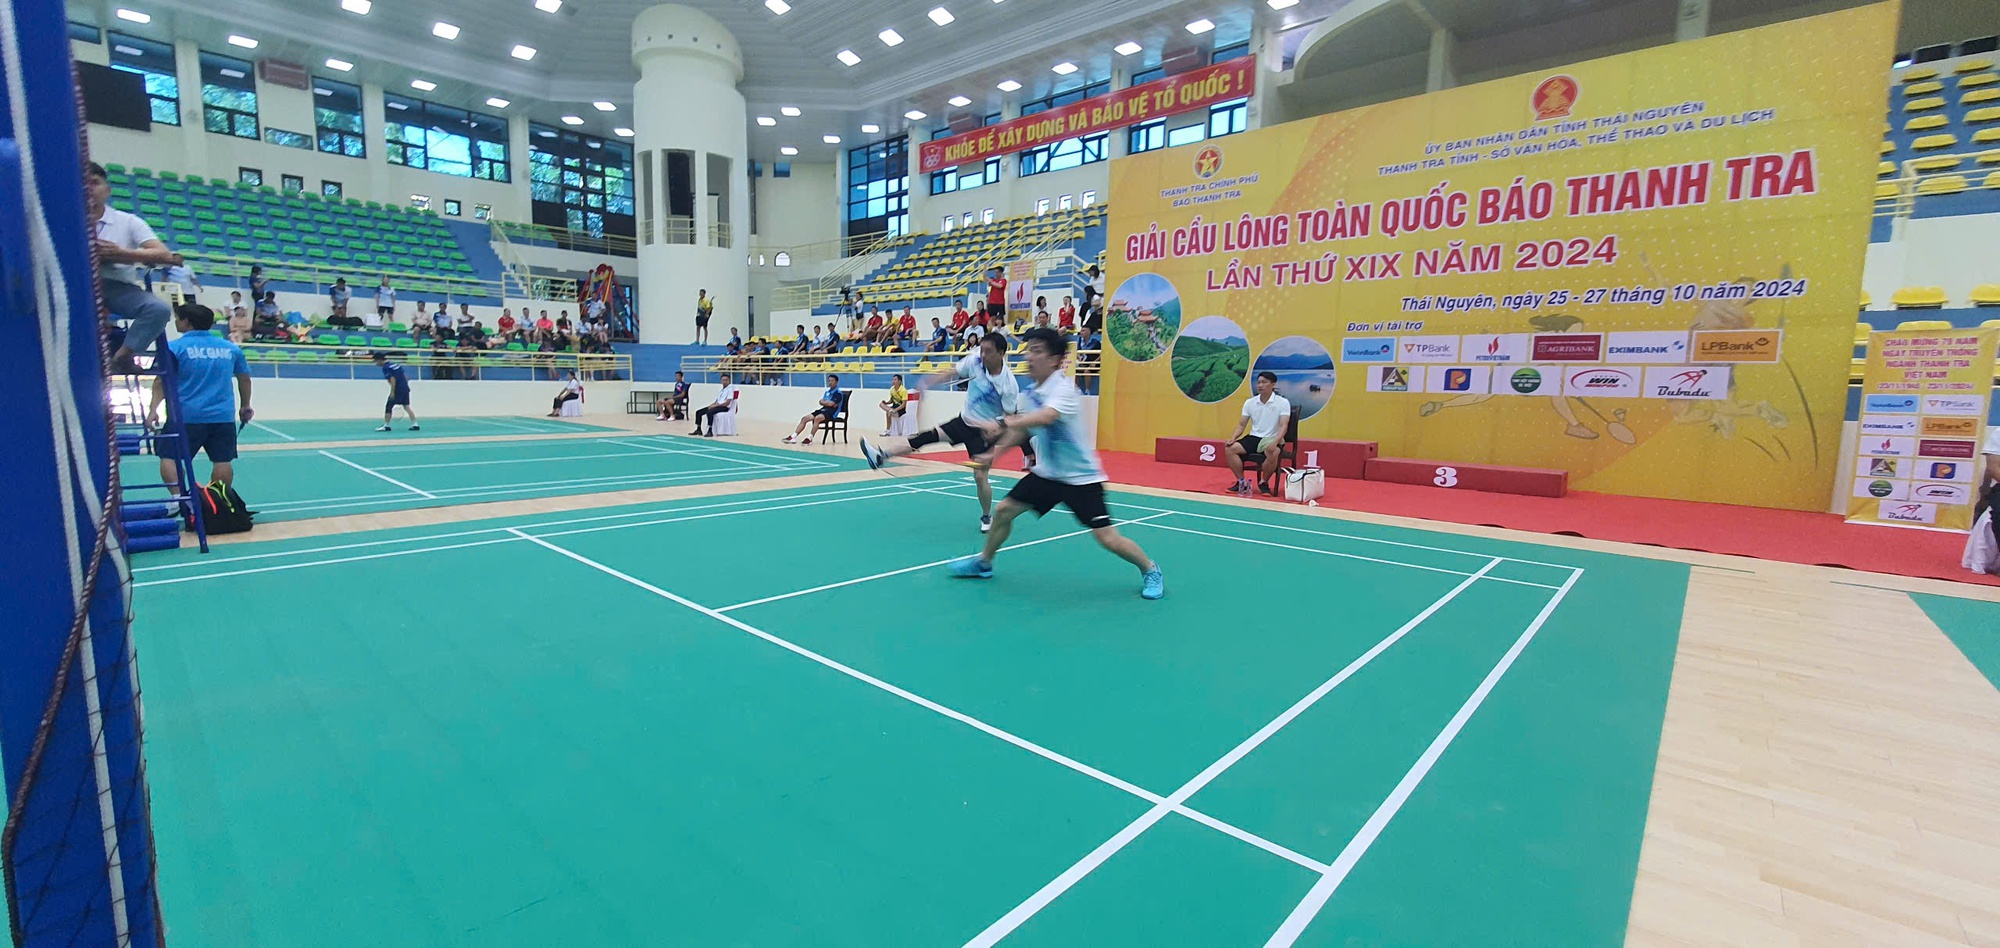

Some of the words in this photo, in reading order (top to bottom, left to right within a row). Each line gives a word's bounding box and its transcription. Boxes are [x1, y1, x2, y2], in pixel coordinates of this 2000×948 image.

[945, 137, 976, 162] KHỎE
[997, 125, 1024, 149] XÂY
[1026, 117, 1065, 143] DỰNG
[1069, 108, 1088, 131] VÀ
[1092, 98, 1124, 126] BẢO
[1128, 91, 1149, 118] VỆ
[1154, 80, 1177, 110] TỔ
[1180, 69, 1231, 105] QUỐC
[1237, 69, 1245, 90] !
[1445, 139, 1473, 151] BAN
[1475, 132, 1514, 147] NHÂN
[1518, 126, 1548, 140] DÂN
[1592, 112, 1627, 128] THÁI
[1632, 101, 1705, 122] NGUYÊN
[1378, 162, 1418, 175] THANH
[1421, 158, 1445, 170] TRA
[1623, 124, 1668, 140] THAO
[1673, 120, 1695, 133] VÀ
[1700, 116, 1726, 129] DU
[1731, 107, 1775, 126] LỊCH
[1160, 187, 1187, 198] THANH
[1190, 184, 1206, 194] TRA
[1193, 192, 1222, 204] THANH
[1224, 189, 1241, 200] TRA
[1126, 222, 1166, 262] GIẢI
[1173, 216, 1217, 257] CẦU
[1224, 213, 1288, 251] LÔNG
[1298, 201, 1371, 243] TOÀN
[1381, 181, 1467, 238] QUỐC
[1478, 177, 1553, 224] BÁO
[1567, 163, 1709, 215] THANH
[1726, 150, 1814, 200] TRA
[1206, 258, 1261, 290] LẦN
[1272, 252, 1337, 285] THỨ
[1345, 253, 1401, 281] XIX
[1414, 240, 1501, 276] NĂM
[1516, 236, 1617, 269] 2024
[1402, 295, 1431, 311] Thái
[1435, 294, 1496, 312] Nguyên,
[1502, 292, 1543, 310] ngày
[1547, 290, 1568, 305] 25
[1584, 289, 1606, 303] 27
[1610, 285, 1665, 304] tháng
[1674, 285, 1695, 299] 10
[1700, 282, 1745, 299] năm
[1752, 279, 1806, 297] 2024
[1347, 322, 1369, 332] Đơn
[1373, 321, 1383, 332] vị
[1387, 320, 1401, 331] tài
[1404, 321, 1423, 331] trợ
[1416, 344, 1450, 353] TPBank
[1547, 344, 1595, 353] AGRIBANK
[1608, 346, 1669, 354] EXIMBANK
[1701, 341, 1754, 351] LPBank
[1657, 385, 1713, 397] Bubadu
[1200, 444, 1216, 461] 2
[1303, 450, 1321, 468] 1
[1433, 467, 1458, 487] 3
